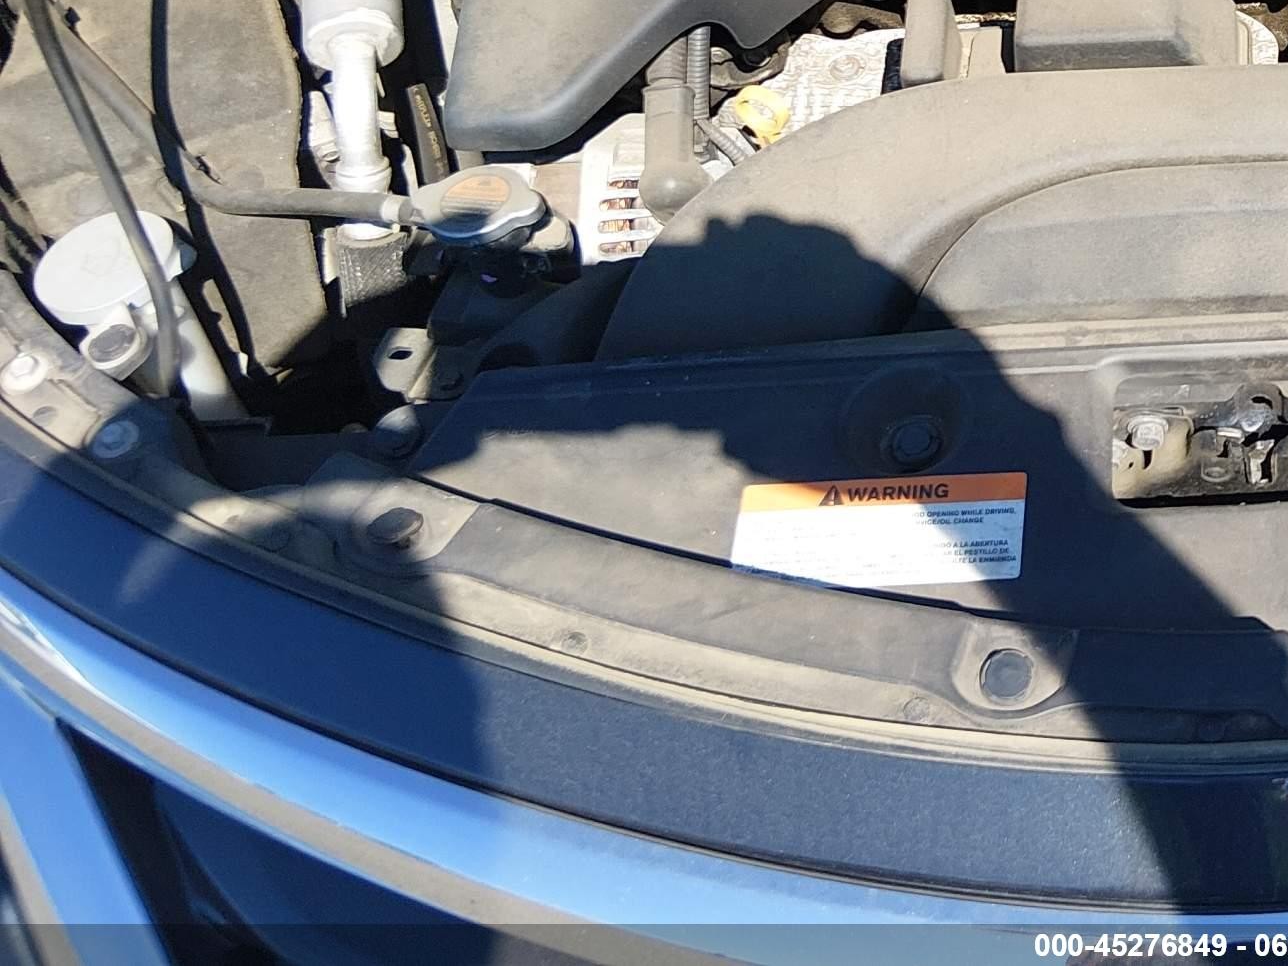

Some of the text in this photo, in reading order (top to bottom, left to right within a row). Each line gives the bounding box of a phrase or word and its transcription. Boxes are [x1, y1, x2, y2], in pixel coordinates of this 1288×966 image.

[847, 483, 950, 502] WARNING
[926, 510, 960, 518] OPENING
[960, 509, 983, 517] WHILE
[984, 507, 1017, 516] DRIVING,
[953, 517, 984, 525] CHANGE
[970, 539, 1009, 547] ABERTURA
[964, 548, 999, 556] PESTILLO
[978, 555, 1017, 563] ENMIENDA
